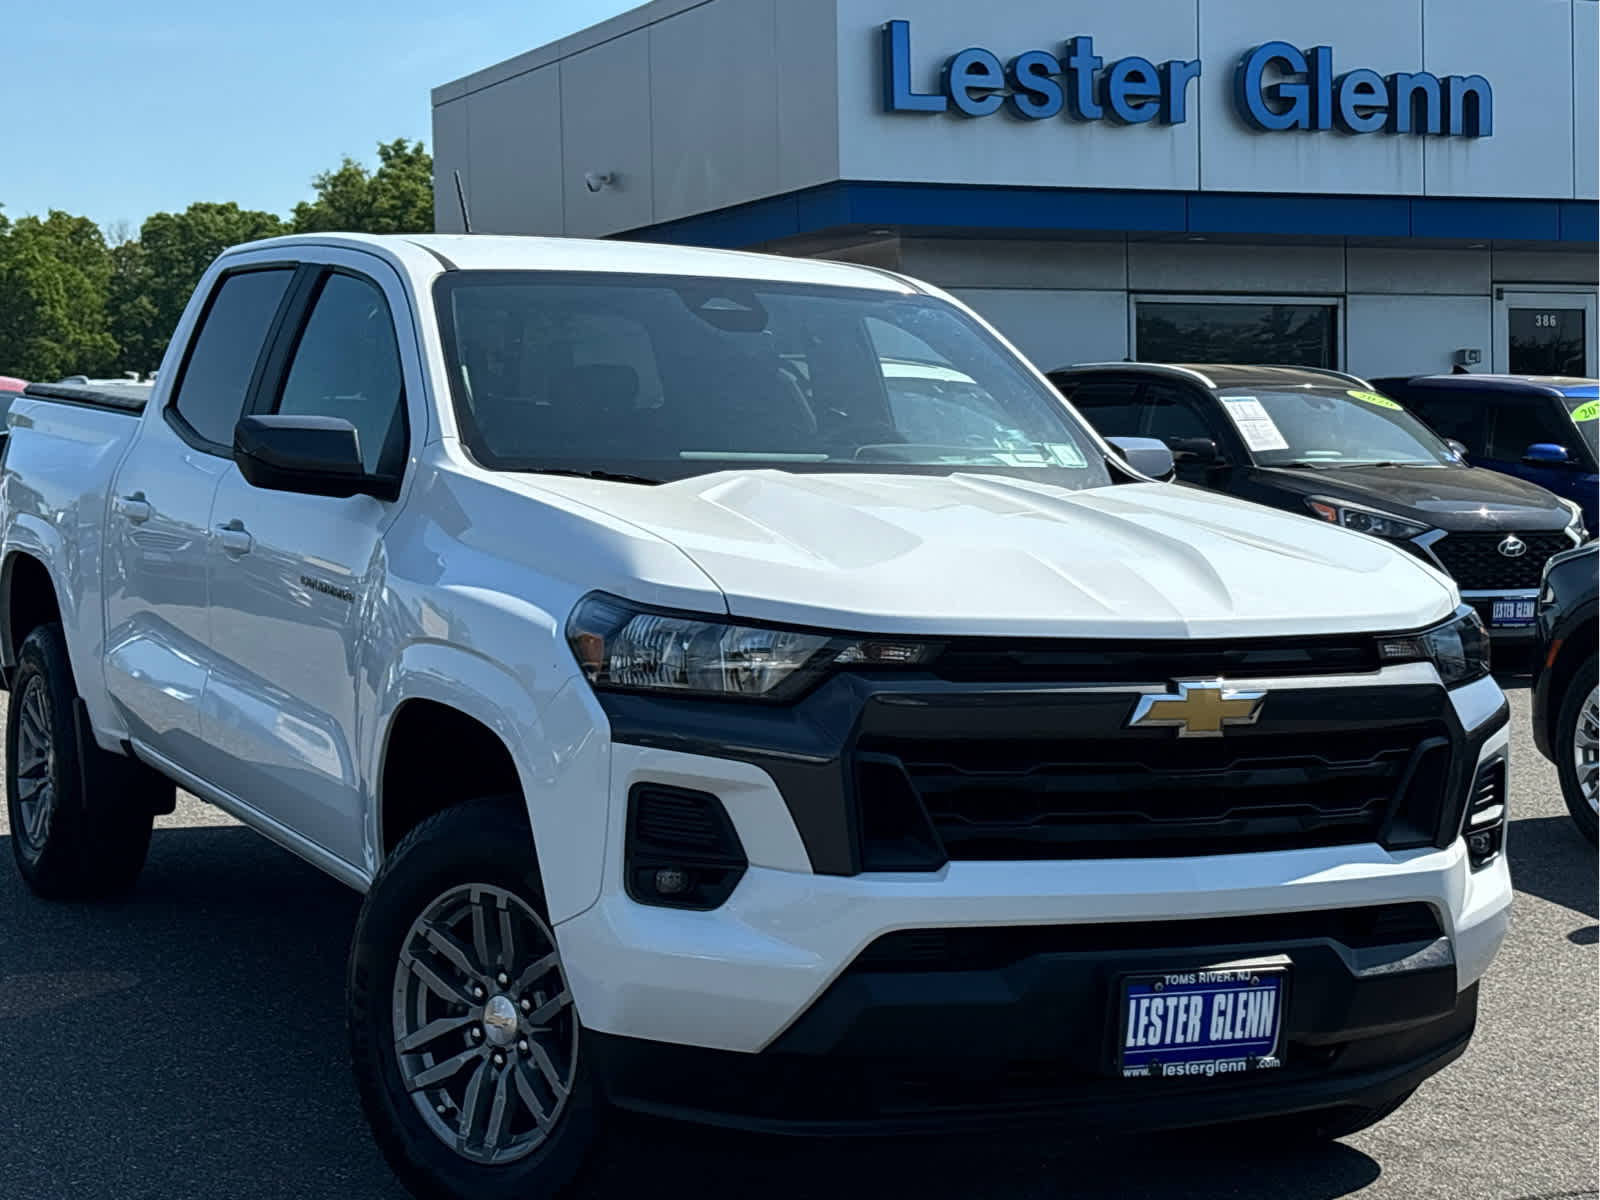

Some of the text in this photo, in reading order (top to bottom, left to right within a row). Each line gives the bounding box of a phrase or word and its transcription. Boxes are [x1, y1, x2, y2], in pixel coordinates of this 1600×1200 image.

[883, 20, 1493, 137] Lester Glenn
[1535, 314, 1557, 327] 386
[1164, 974, 1196, 985] TOMS
[1237, 970, 1251, 981] NJ
[1125, 990, 1276, 1047] LESTER GLENN
[1162, 1060, 1247, 1077] lesterglenn
